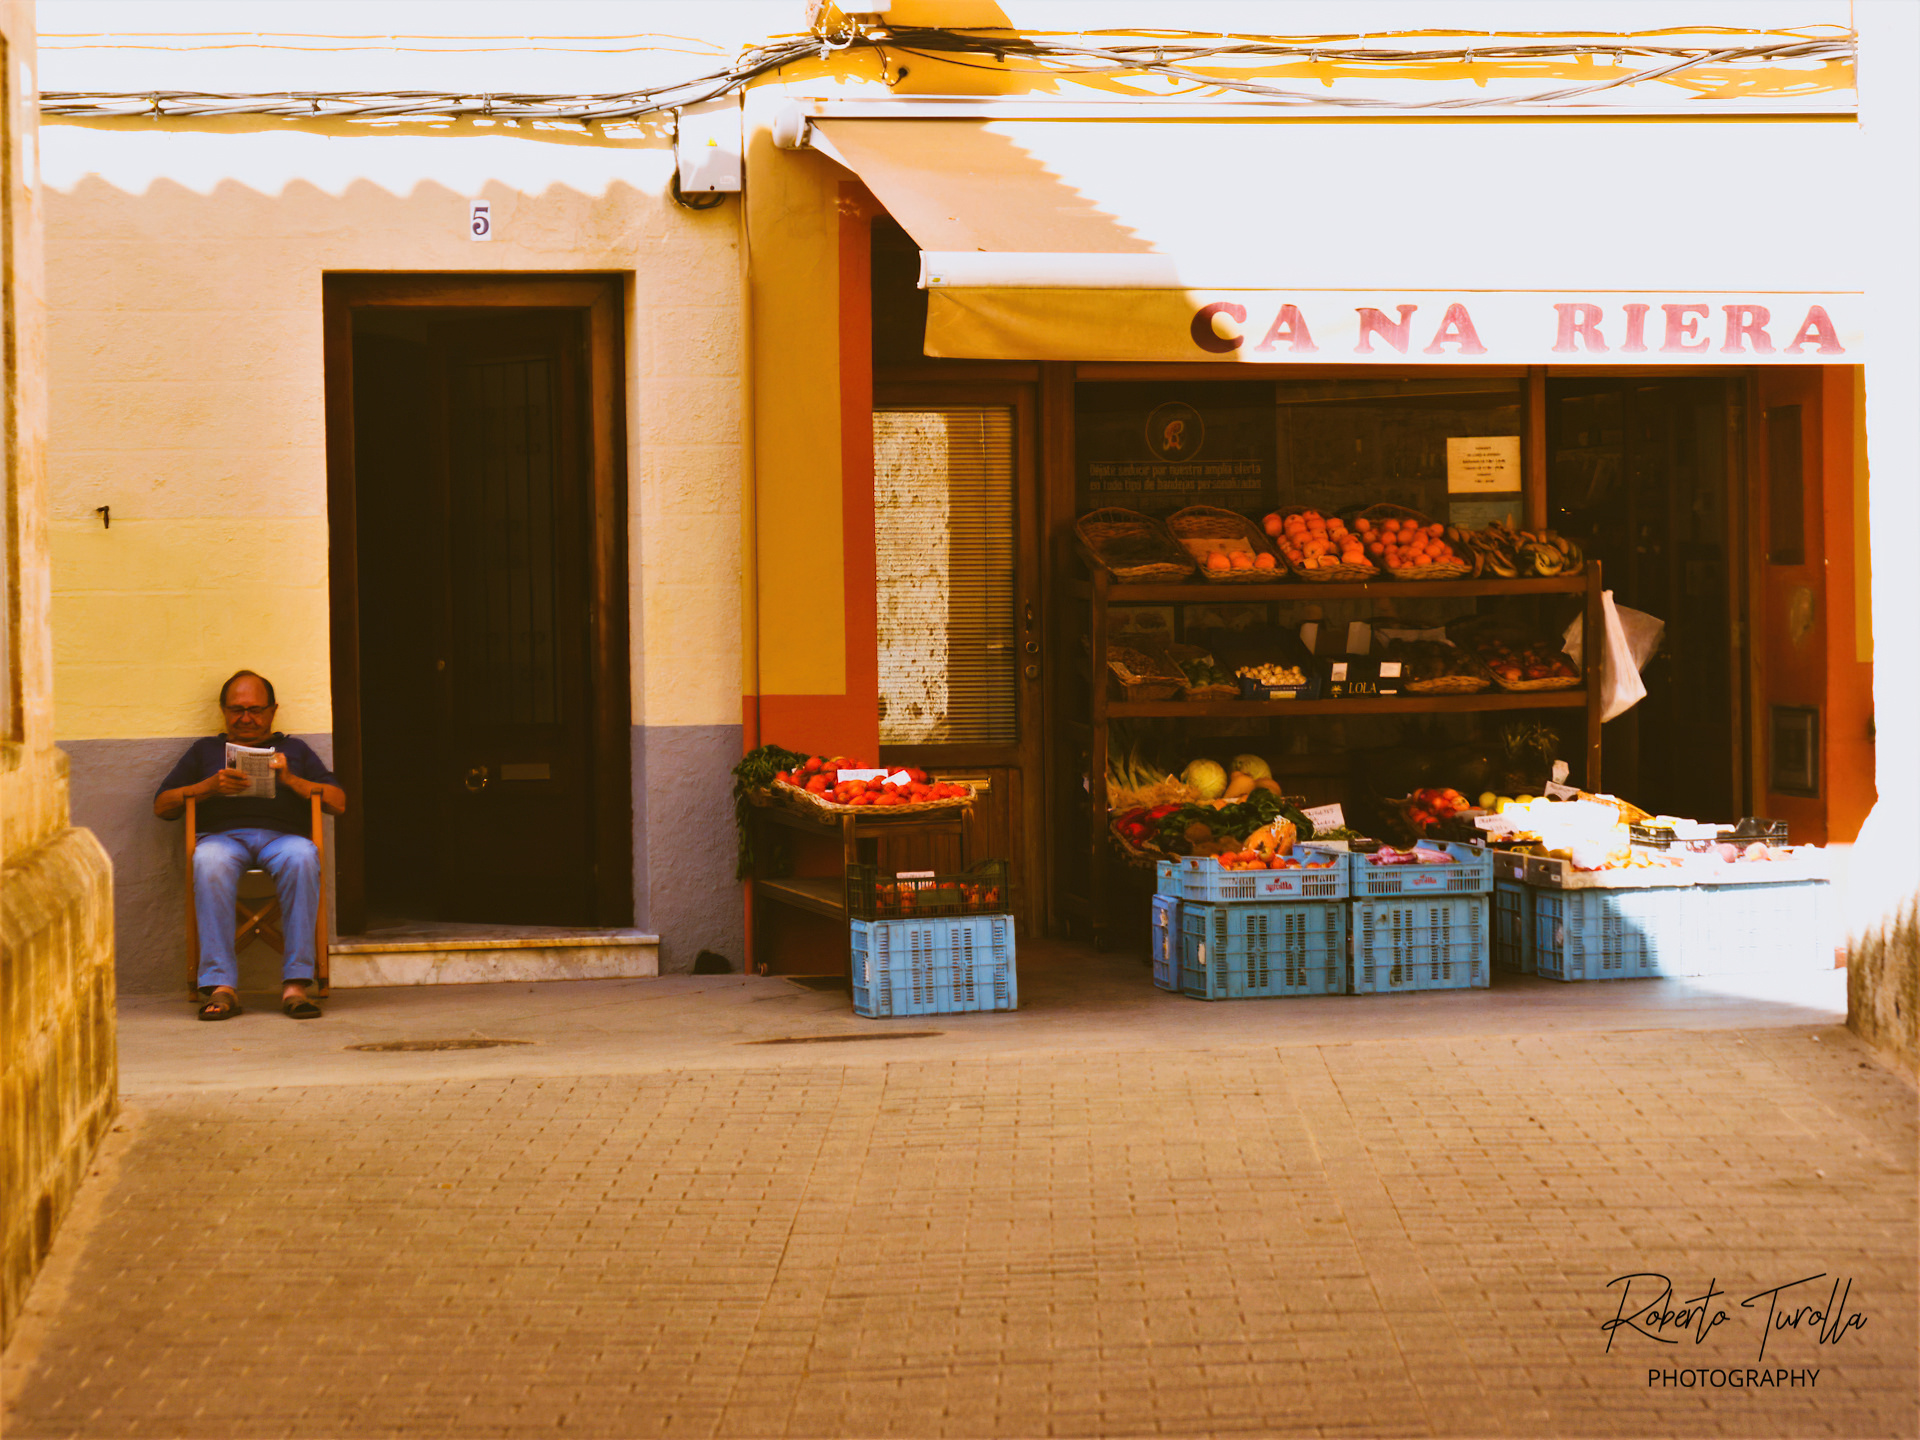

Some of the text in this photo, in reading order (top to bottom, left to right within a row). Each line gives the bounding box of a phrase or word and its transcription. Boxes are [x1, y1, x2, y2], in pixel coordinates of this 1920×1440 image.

[472, 206, 490, 236] 5
[1190, 301, 1847, 355] CA NA RIERA
[1152, 465, 1168, 478] por
[1348, 682, 1377, 694] LOLA
